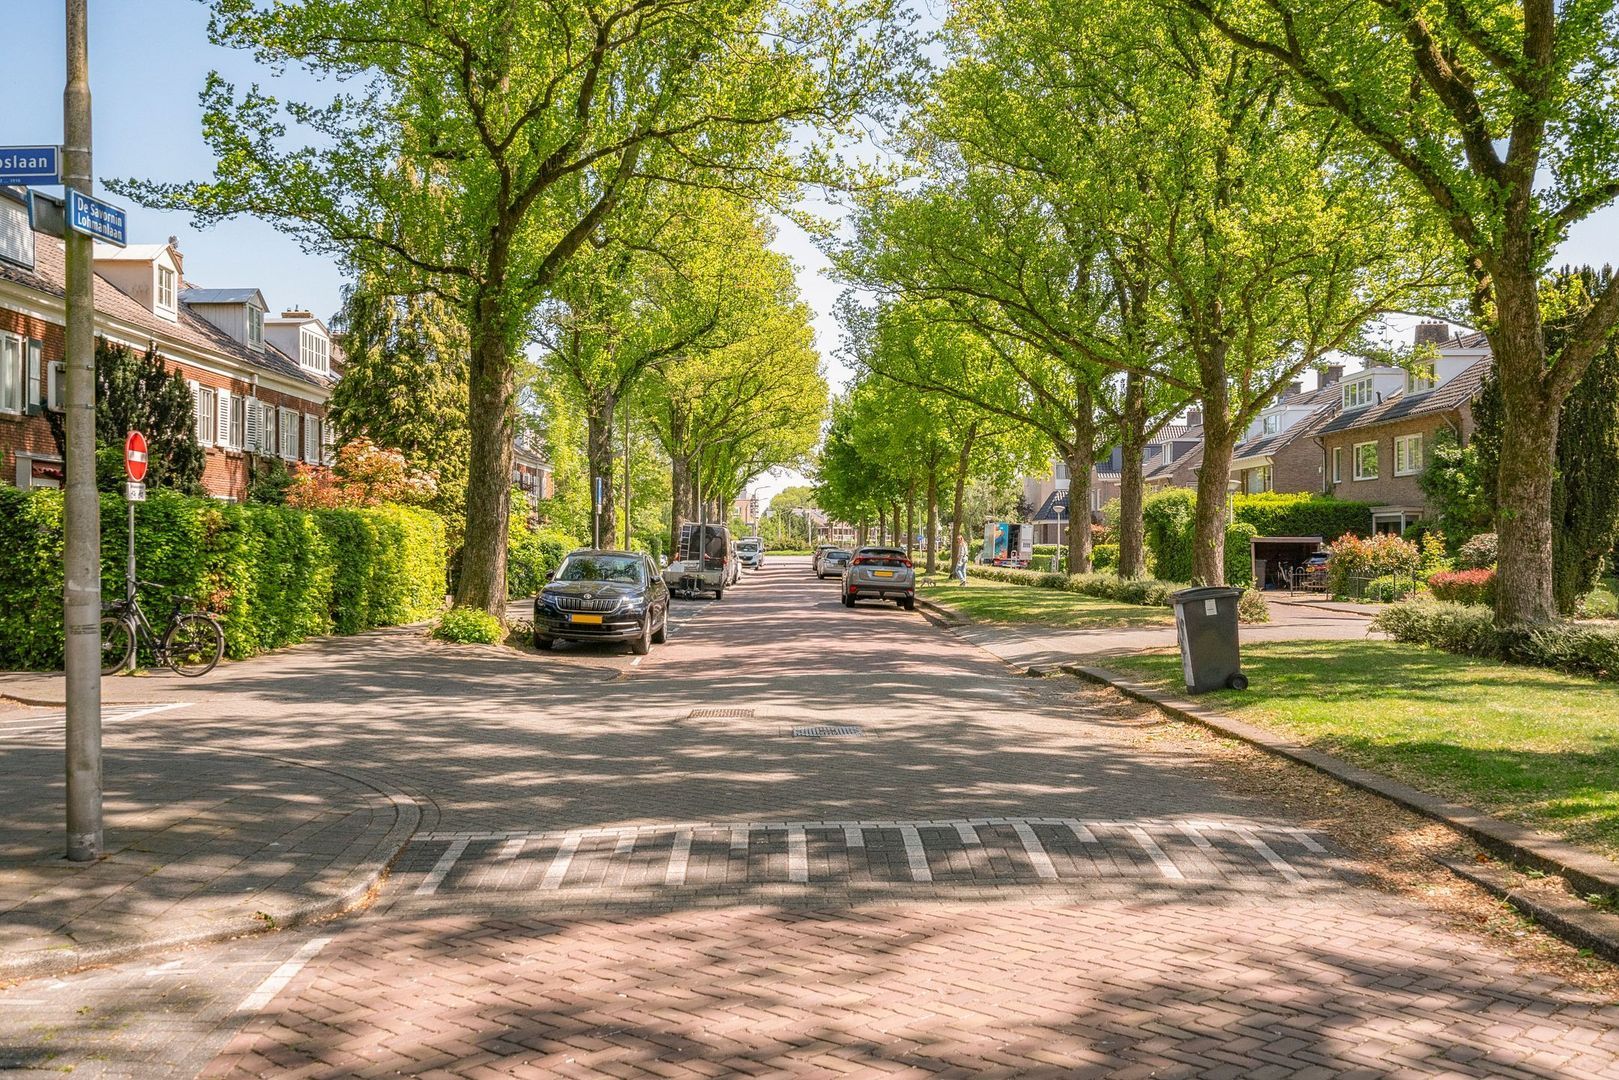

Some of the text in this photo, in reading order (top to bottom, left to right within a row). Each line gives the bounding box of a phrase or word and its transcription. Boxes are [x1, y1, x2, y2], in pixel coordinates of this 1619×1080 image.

[77, 197, 122, 227] De Savornin
[77, 212, 122, 240] Lohmanlaan
